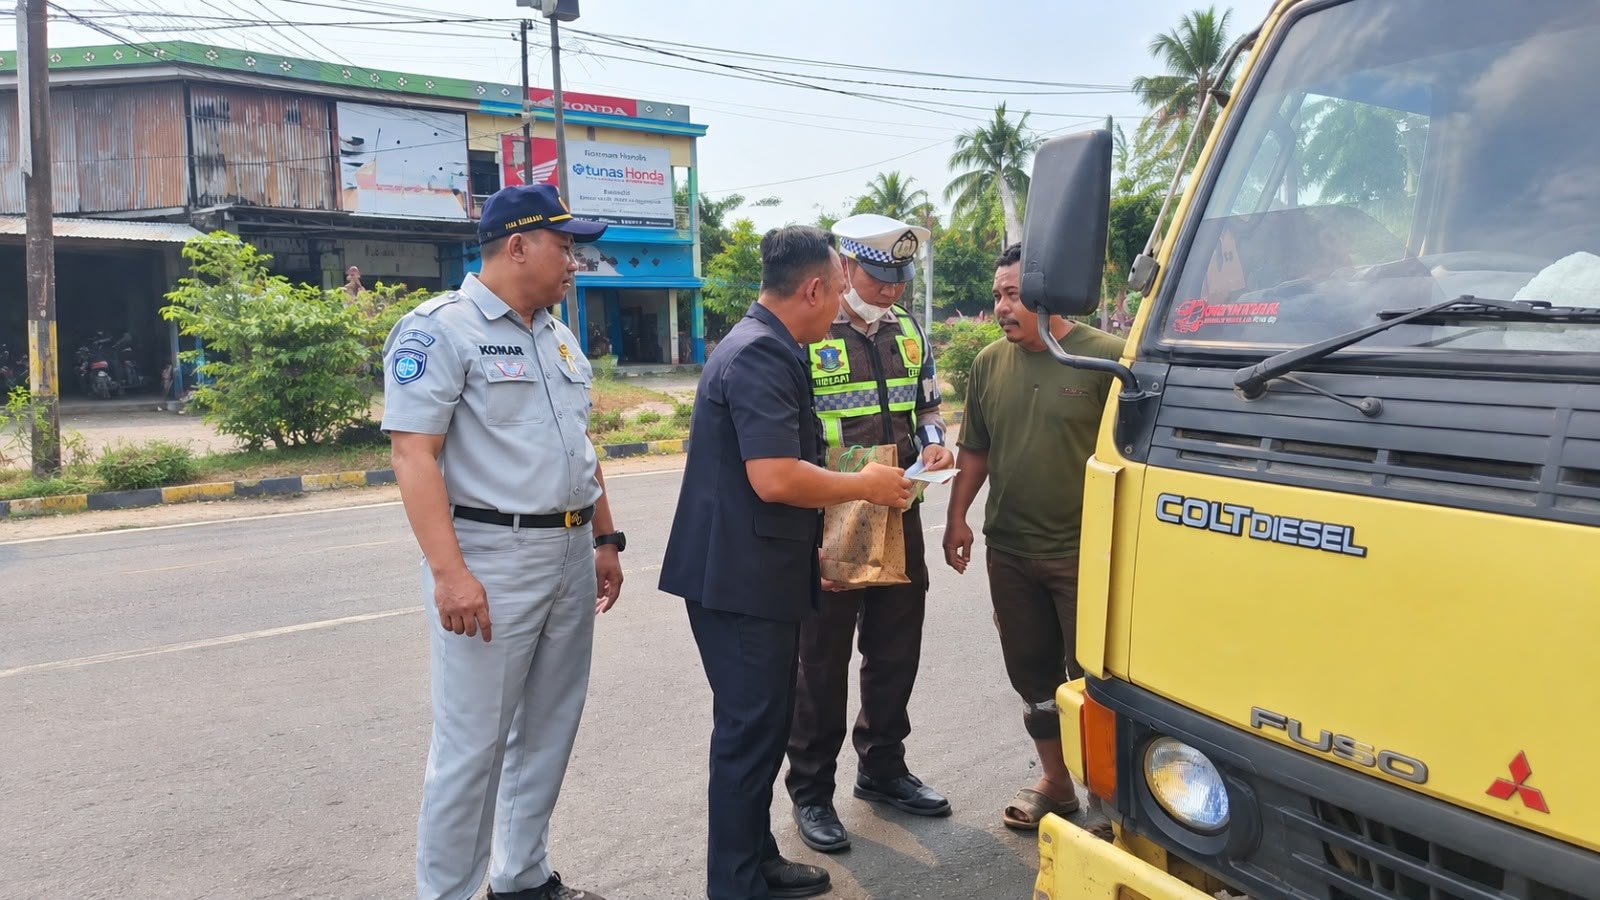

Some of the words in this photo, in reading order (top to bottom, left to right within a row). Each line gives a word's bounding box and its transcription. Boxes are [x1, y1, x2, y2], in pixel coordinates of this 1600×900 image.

[585, 164, 624, 178] tunas
[625, 166, 664, 182] Honda
[479, 345, 524, 356] KOMAR
[1251, 706, 1428, 785] FUSO
